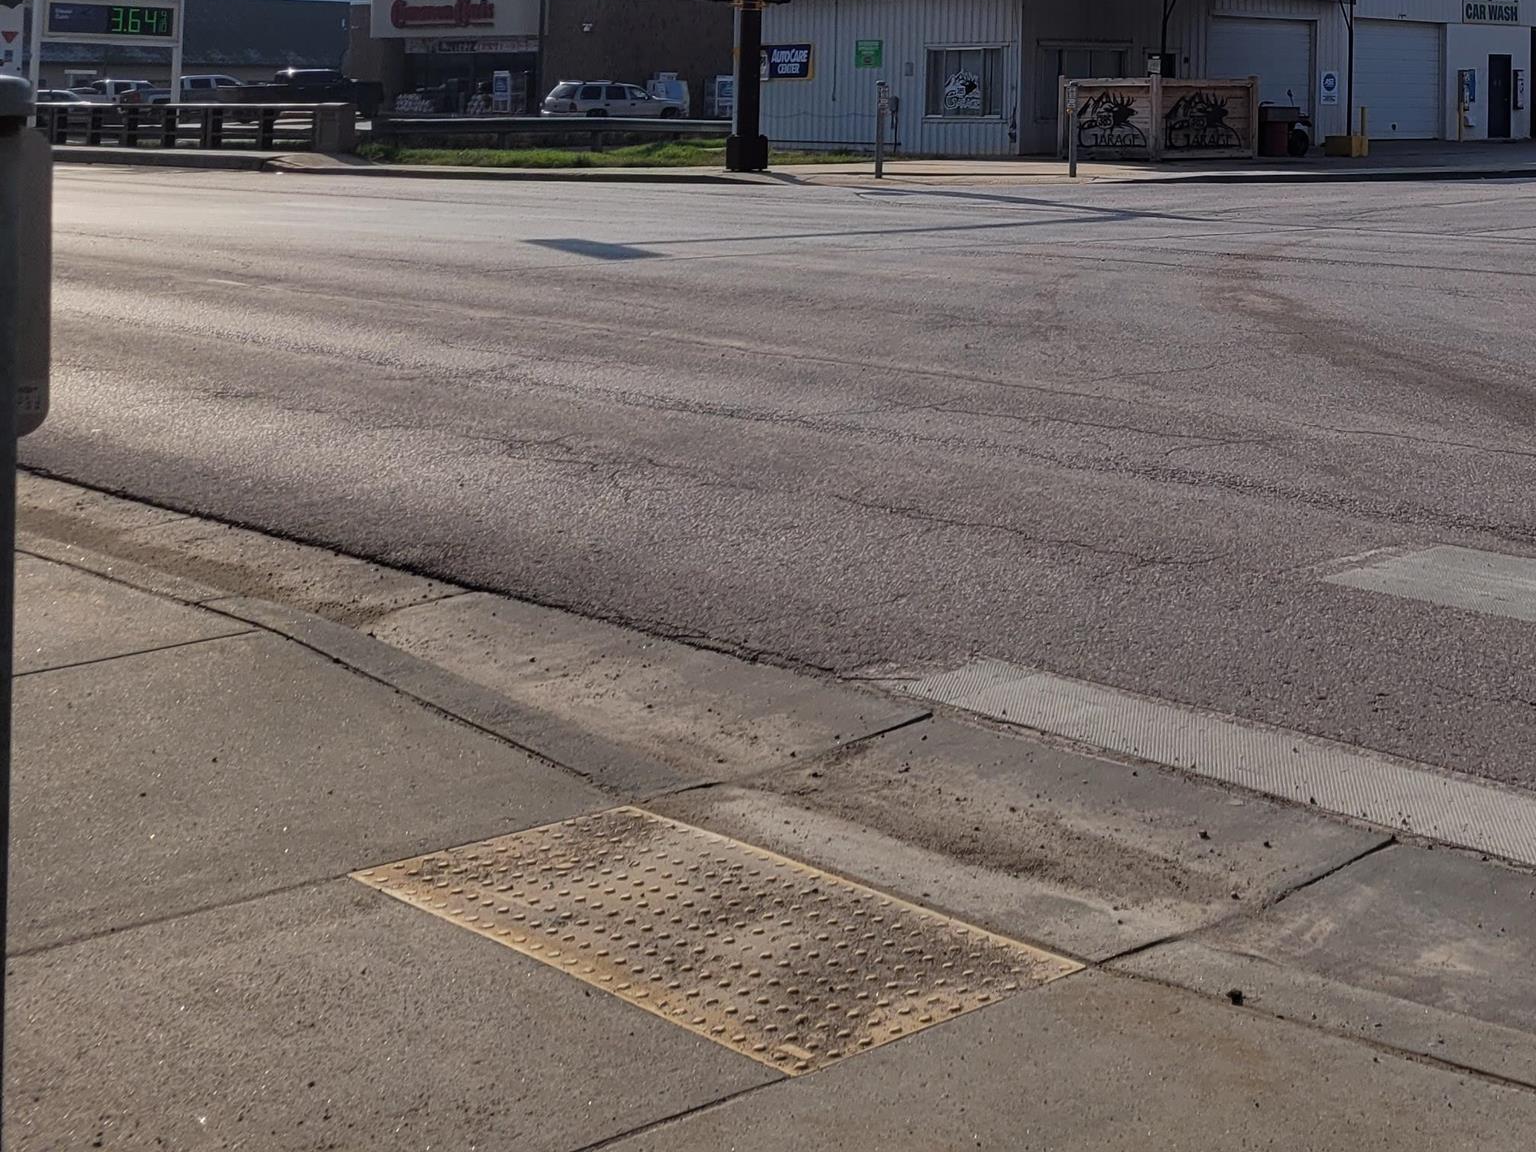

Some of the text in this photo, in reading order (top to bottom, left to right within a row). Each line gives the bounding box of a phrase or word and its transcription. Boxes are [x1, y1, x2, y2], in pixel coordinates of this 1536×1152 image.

[1465, 2, 1519, 22] CAR WASH
[777, 64, 801, 74] CENTER
